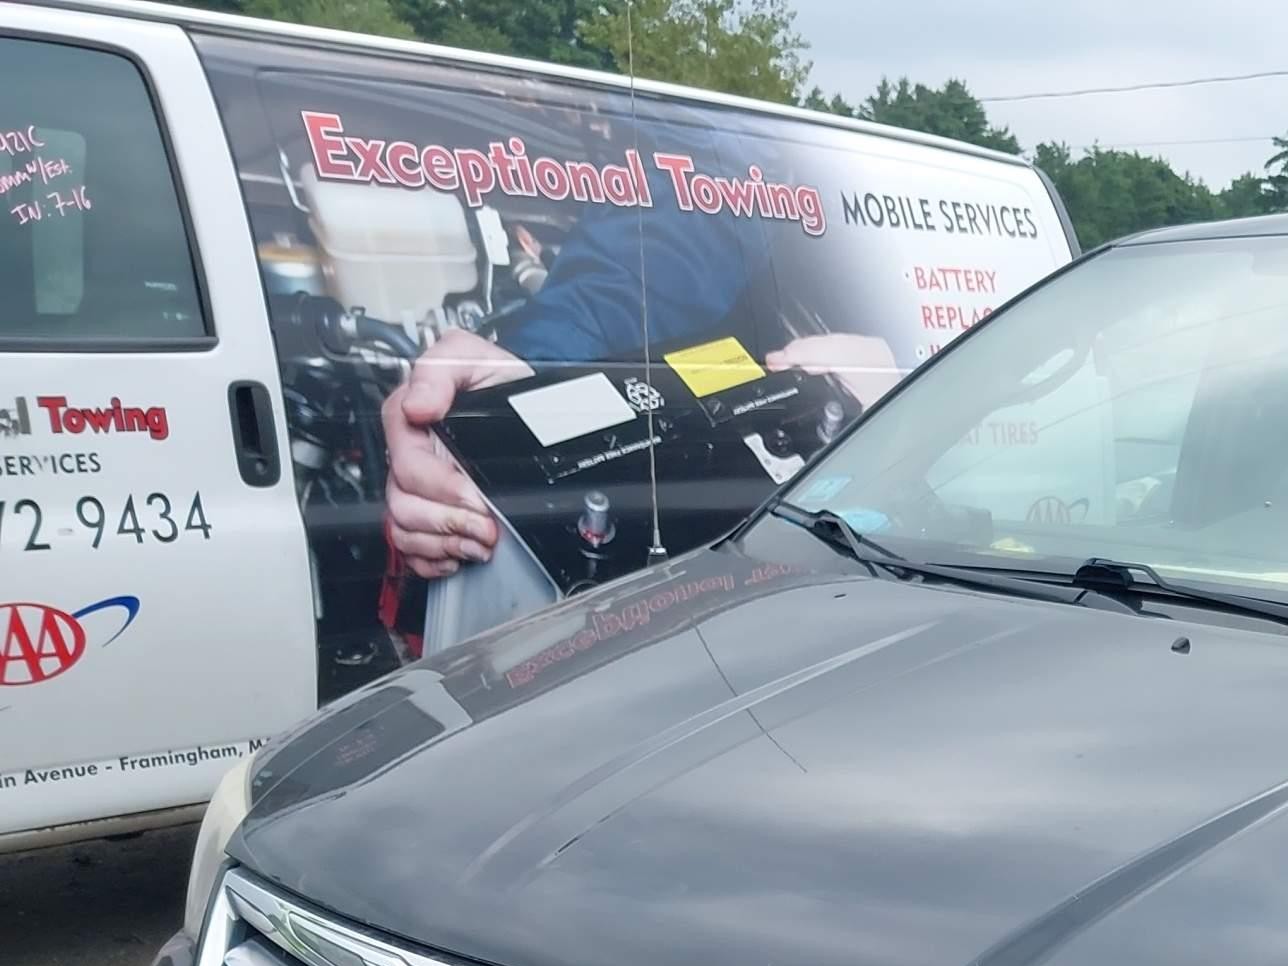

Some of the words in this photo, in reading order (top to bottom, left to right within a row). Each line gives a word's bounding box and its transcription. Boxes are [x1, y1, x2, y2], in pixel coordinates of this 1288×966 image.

[301, 110, 652, 207] Exceptional
[655, 150, 825, 236] Towing
[840, 191, 936, 231] MOBILE
[939, 200, 1038, 239] SERVICES
[914, 266, 997, 294] BATTERY
[37, 396, 169, 440] Towing
[987, 421, 1039, 446] TIRES
[24, 764, 98, 786] Avenue
[119, 745, 243, 771] Framingham,
